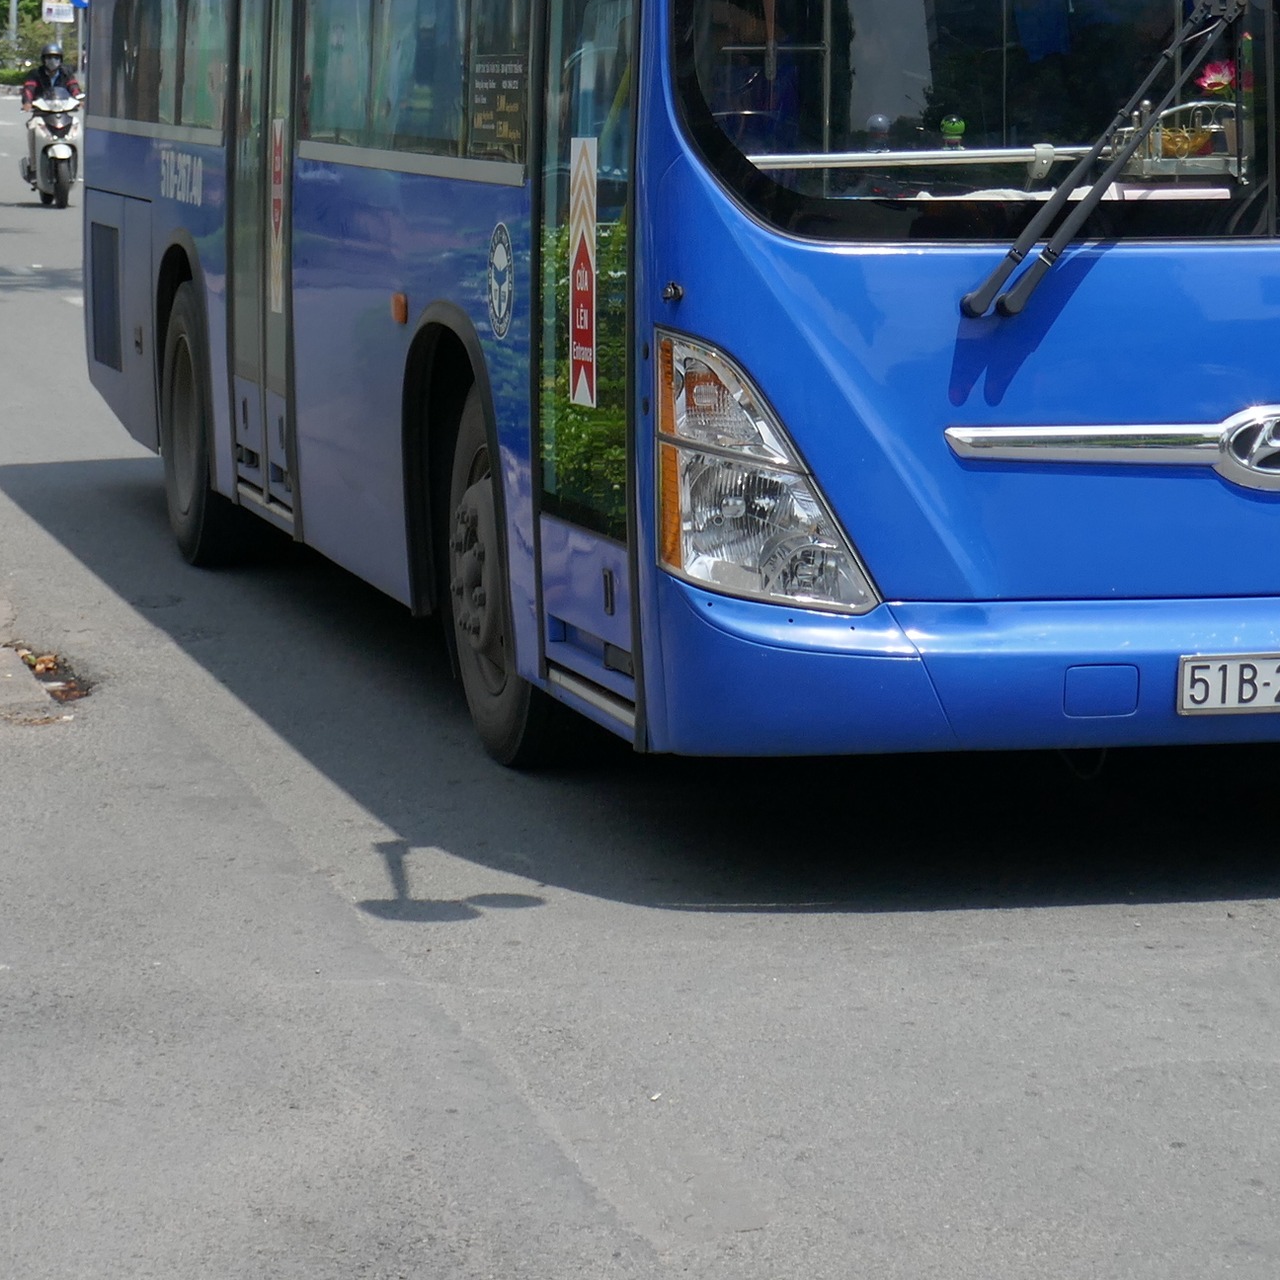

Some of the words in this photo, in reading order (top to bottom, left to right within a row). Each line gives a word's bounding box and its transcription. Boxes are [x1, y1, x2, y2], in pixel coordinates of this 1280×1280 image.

[576, 262, 589, 292] CỬA
[576, 303, 589, 330] LÊN
[573, 340, 593, 363] Entrance
